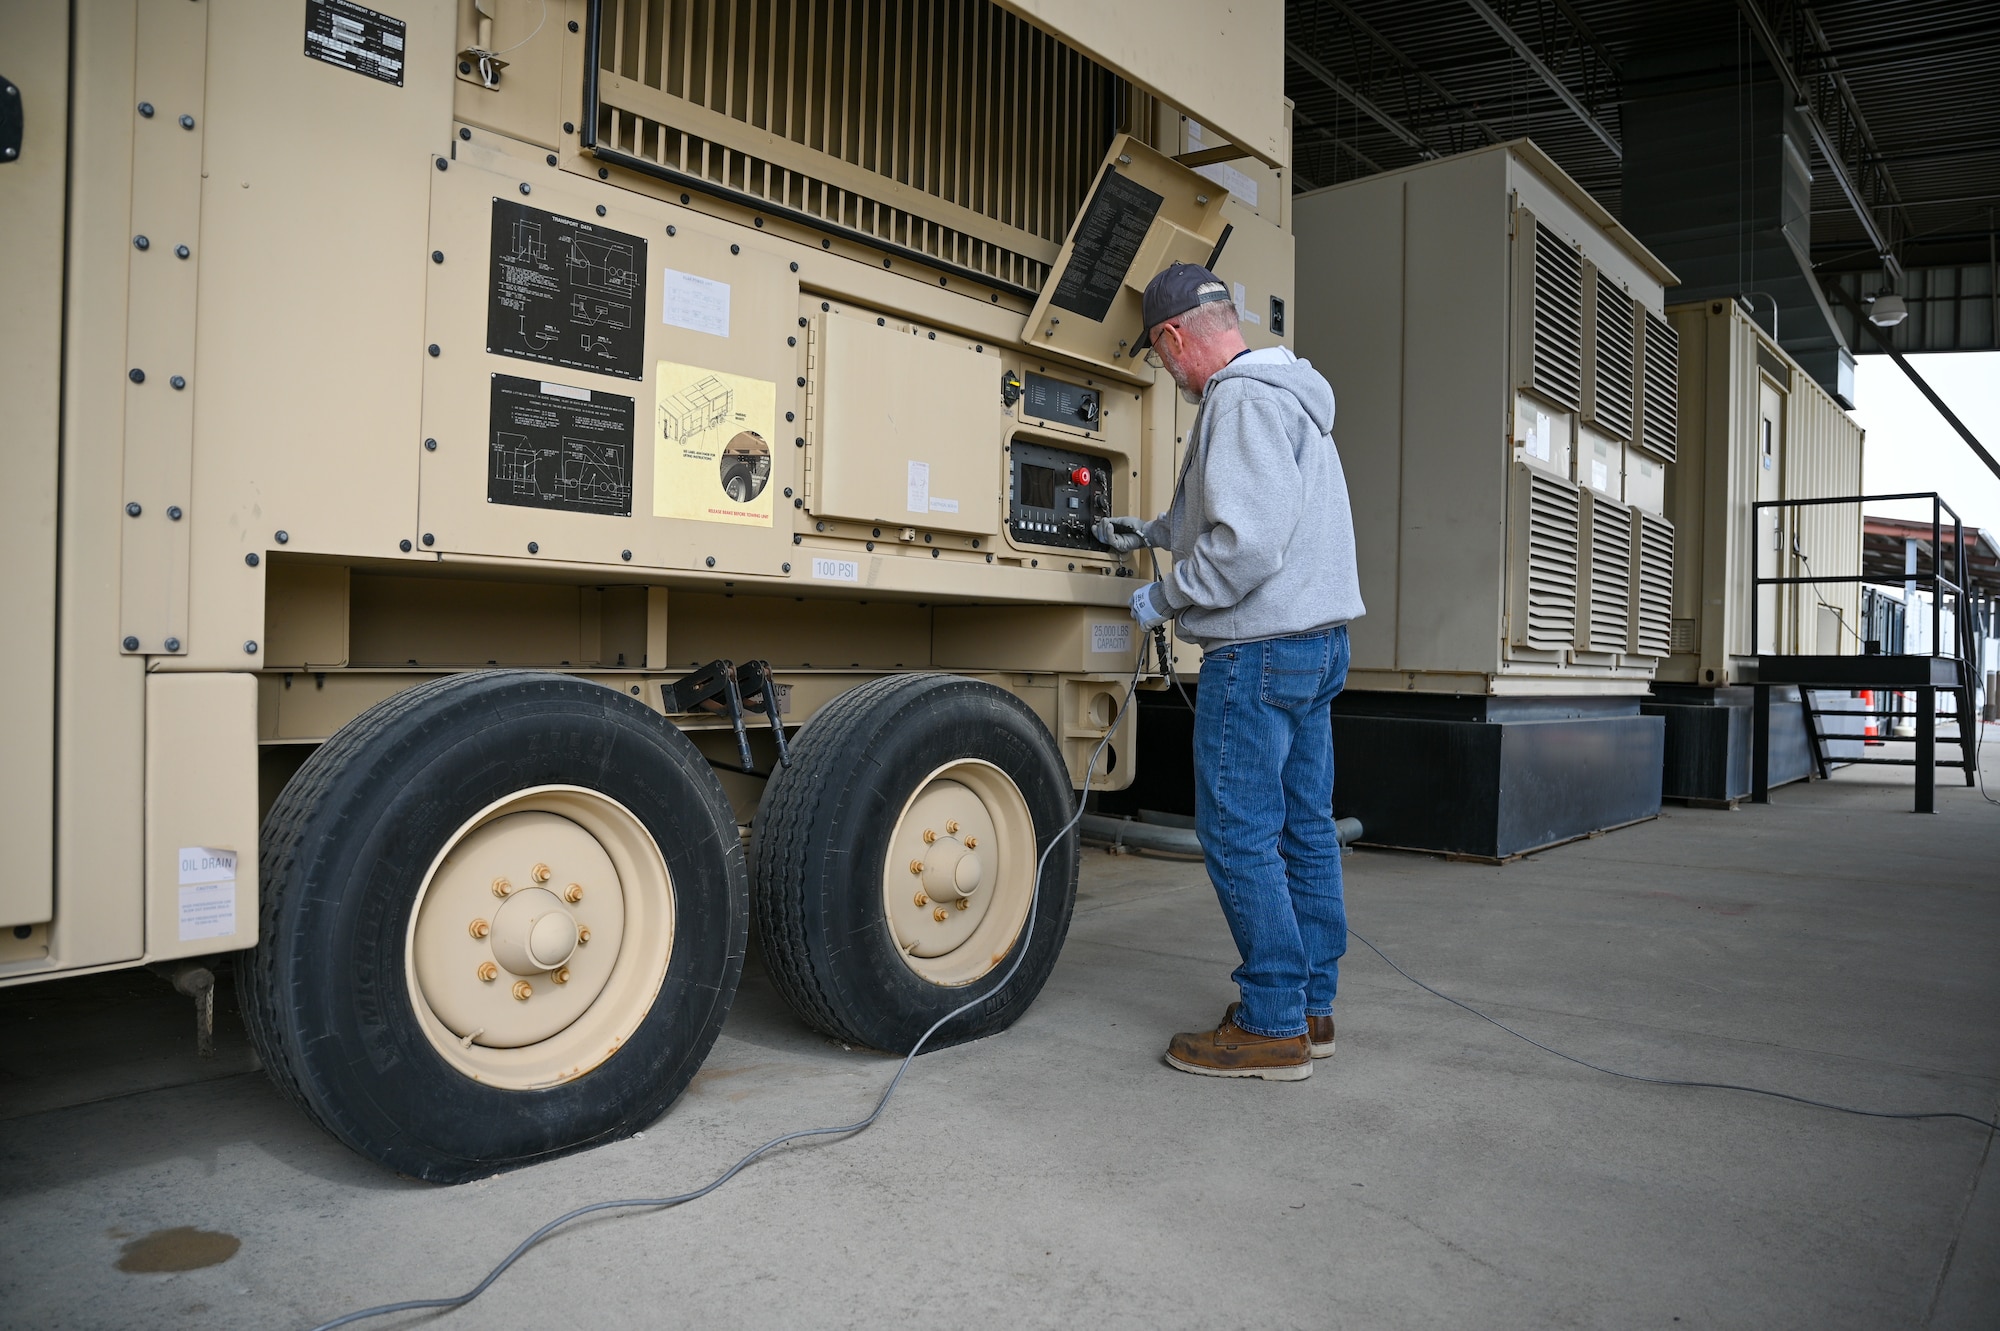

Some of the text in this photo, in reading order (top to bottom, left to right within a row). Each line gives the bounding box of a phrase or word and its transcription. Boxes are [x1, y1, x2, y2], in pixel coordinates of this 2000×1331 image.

[336, 0, 369, 14] DEPARTMENT
[379, 14, 401, 26] DEFENSE
[551, 216, 579, 227] TRANSPORT
[816, 561, 854, 578] 100 PSI
[1094, 625, 1129, 637] 25,000 LBS
[1097, 637, 1127, 650] CAPACITY
[182, 857, 233, 872] OIL DRAIN
